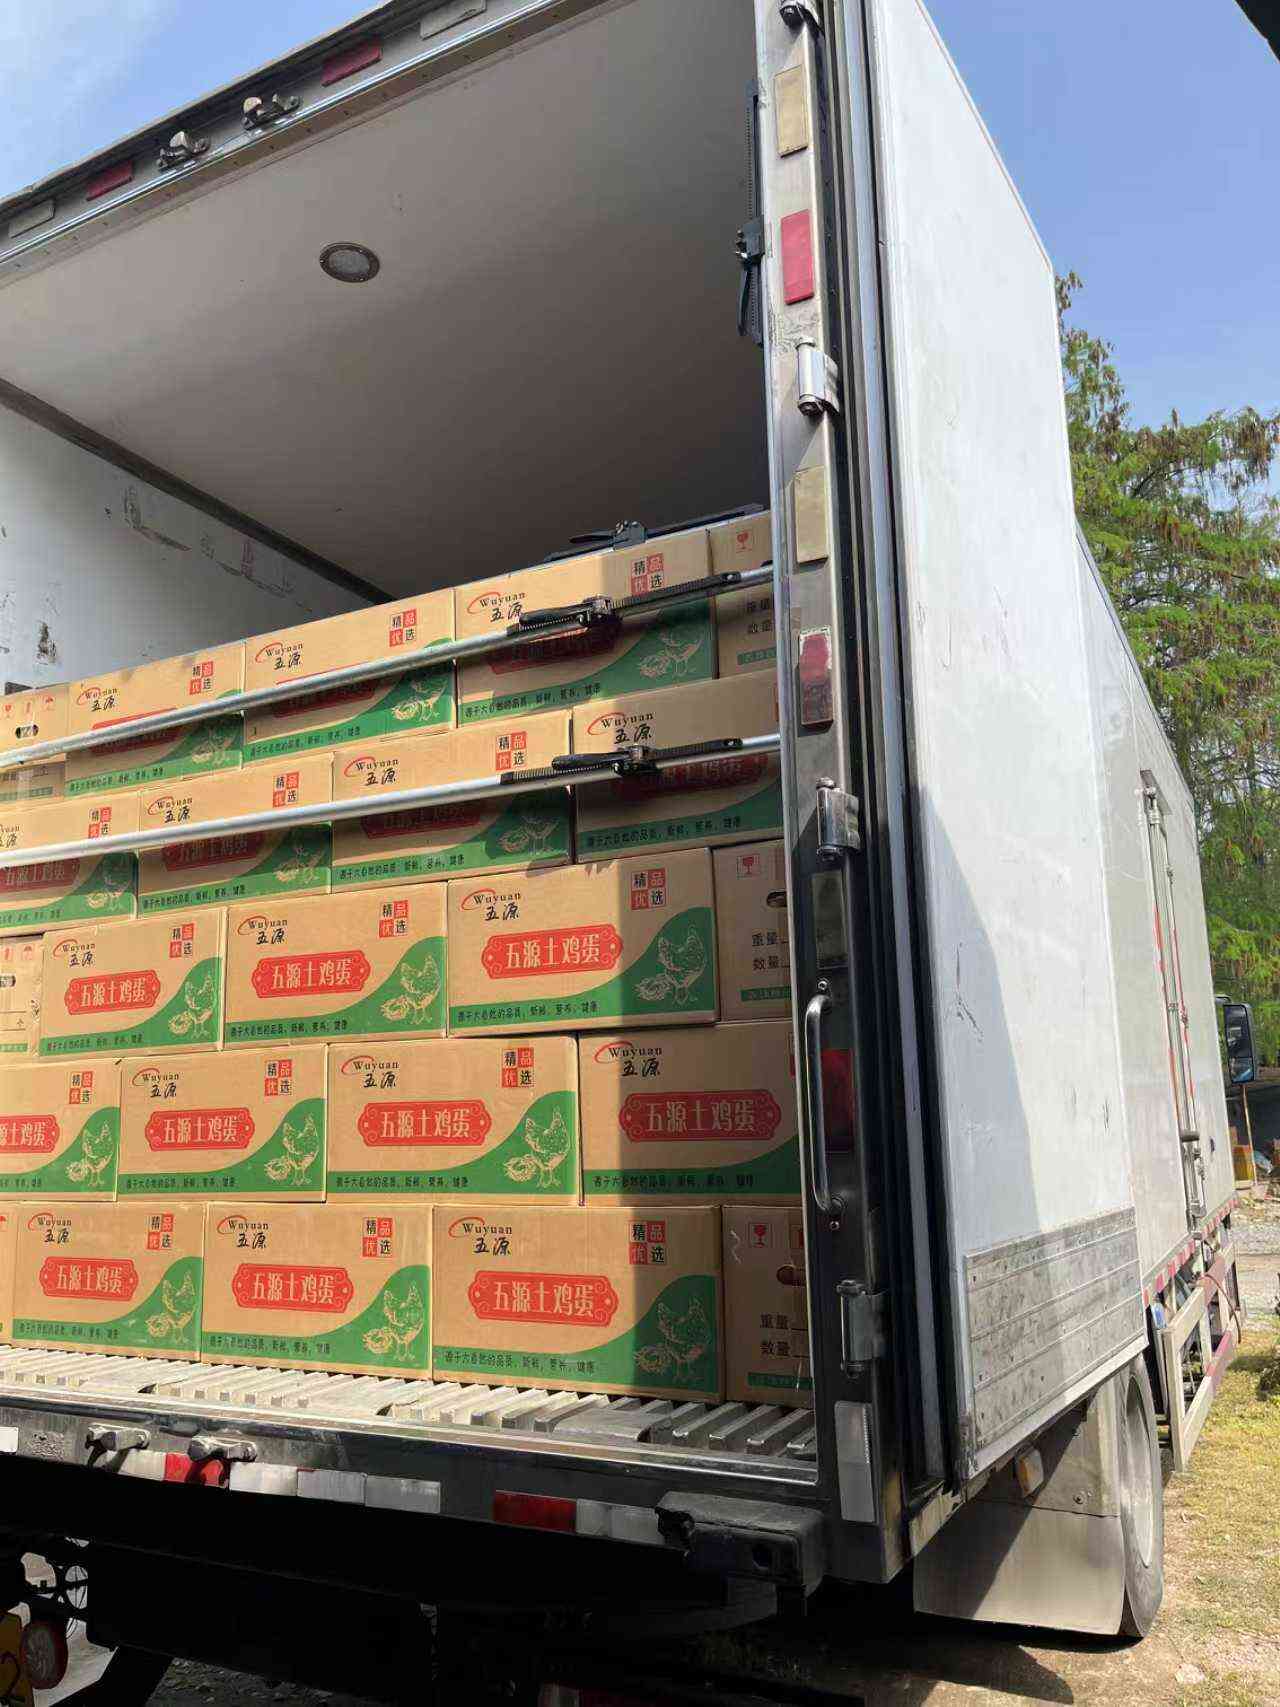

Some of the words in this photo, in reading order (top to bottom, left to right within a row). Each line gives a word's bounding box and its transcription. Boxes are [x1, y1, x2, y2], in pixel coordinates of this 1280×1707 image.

[480, 592, 526, 609] Wuyuan
[490, 604, 523, 622] 五源
[274, 653, 301, 670] 五源
[601, 712, 654, 730] Wuyuan
[614, 725, 653, 744] 五源
[355, 758, 398, 773] Wuyuan
[365, 770, 396, 786] 五源
[165, 806, 191, 823] 五源
[633, 870, 665, 889] 精品
[473, 892, 521, 908] Wuyuan
[485, 903, 518, 921] 五源
[248, 919, 287, 931] Wuyuan
[256, 929, 285, 945] 五源
[505, 934, 601, 968] 五源土鸡蛋
[271, 958, 352, 990] 五源土鸡蛋
[80, 977, 146, 1007] 五源土鸡蛋
[504, 1049, 534, 1067] 精品
[608, 1046, 662, 1060] Wuyuan
[266, 1060, 292, 1077] 精品
[353, 1060, 399, 1073] Wuyuan
[622, 1059, 661, 1077] 五源
[142, 1071, 179, 1083] Wuyuan
[363, 1072, 396, 1089] 五源
[150, 1083, 177, 1098] 五源
[379, 1109, 472, 1138] 五源土鸡蛋
[646, 1100, 756, 1133] 五源土鸡蛋
[162, 1116, 238, 1144] 五源土鸡蛋
[228, 1219, 269, 1232] Wuyuan
[365, 1218, 392, 1237] 精品
[462, 1223, 513, 1237] Wuyuan
[632, 1221, 665, 1242] 精品
[44, 1228, 70, 1244] 五源
[236, 1233, 267, 1249] 五源
[473, 1237, 512, 1256] 五源
[56, 1265, 123, 1294] 五源土鸡蛋
[251, 1272, 336, 1304] 五源土鸡蛋
[493, 1280, 594, 1318] 五源土鸡蛋
